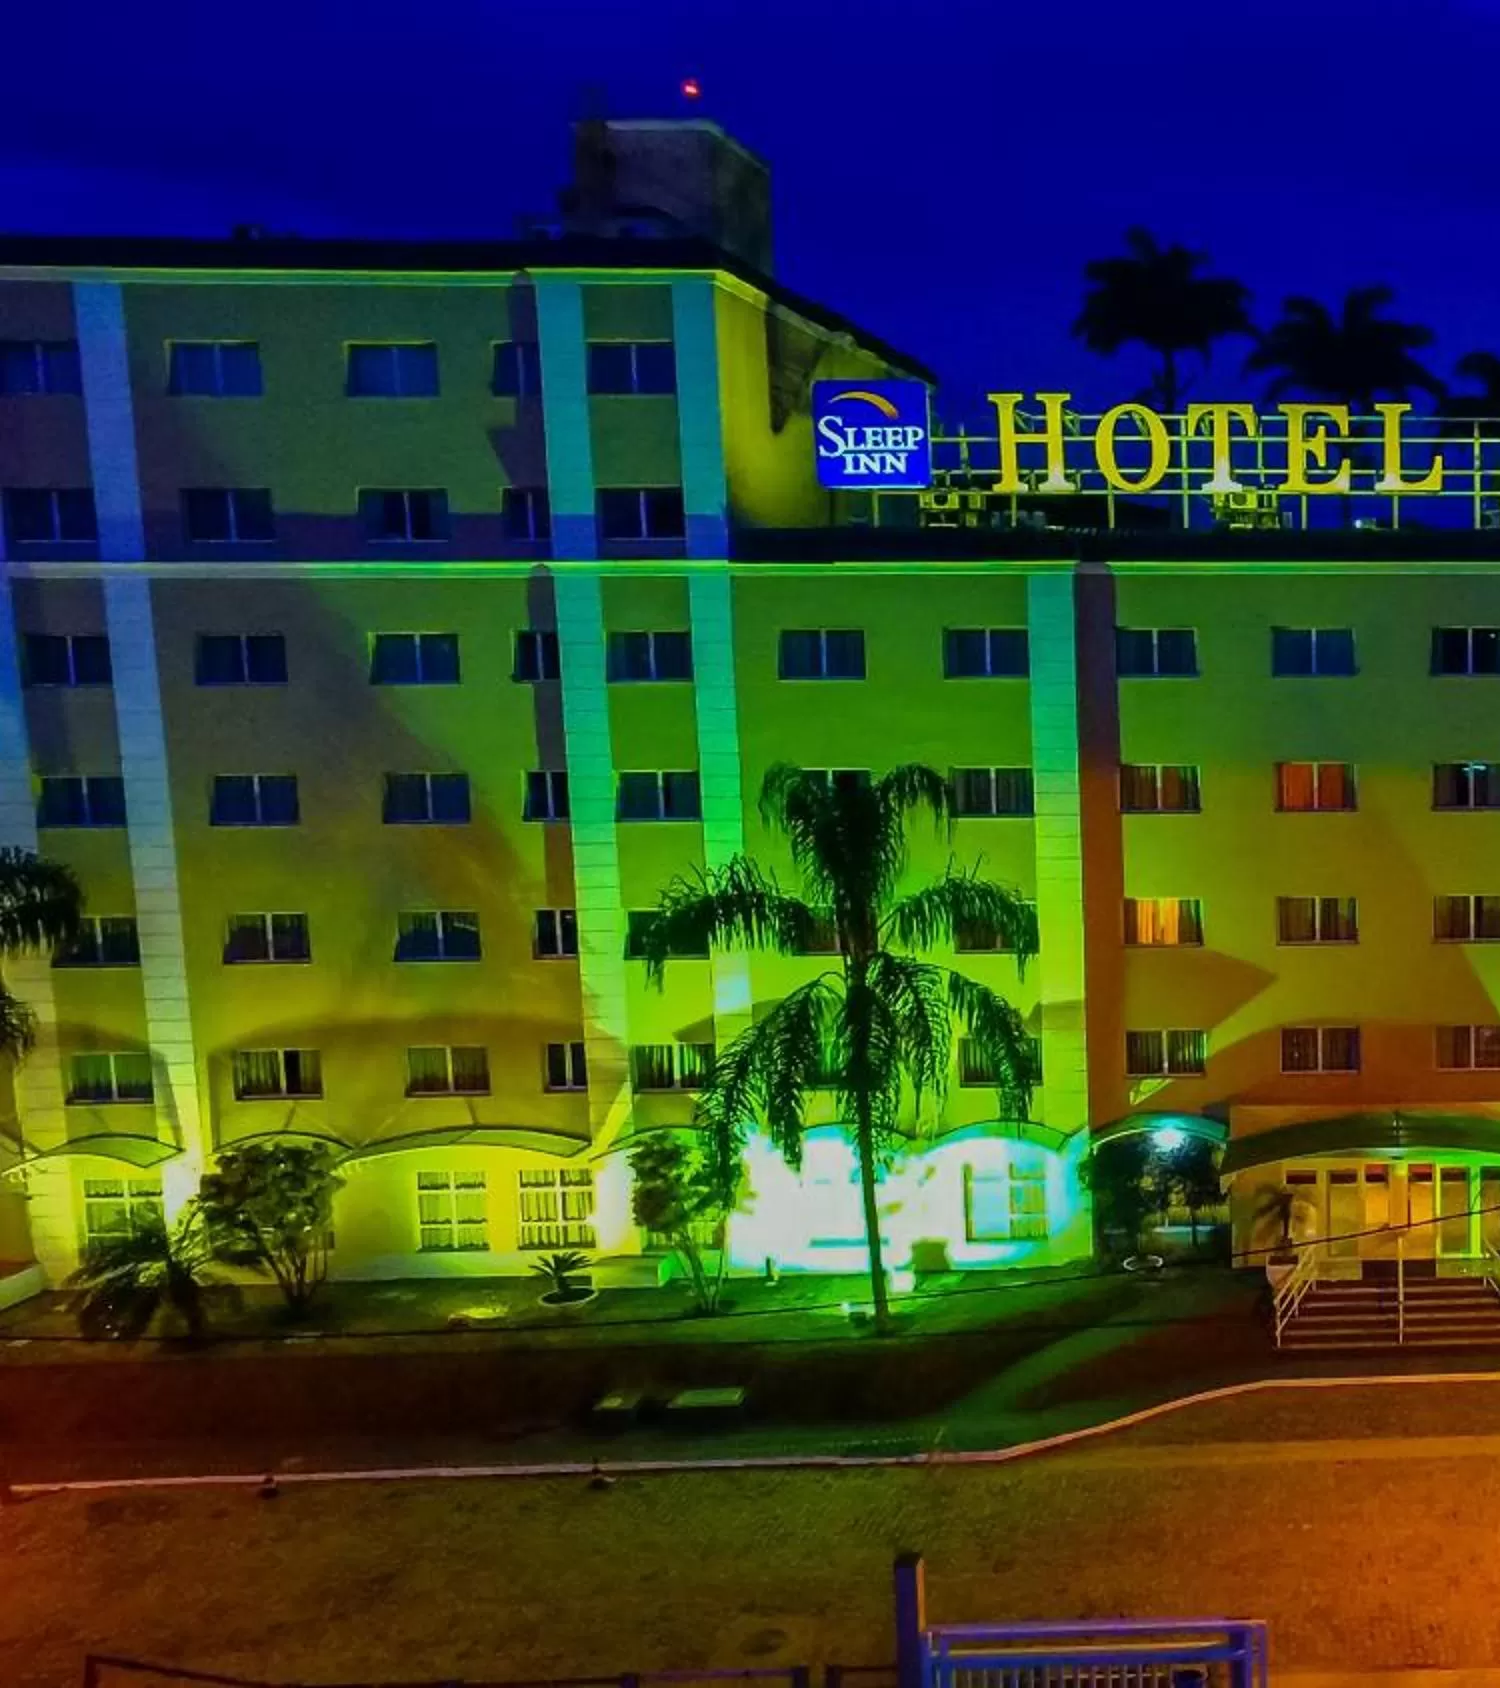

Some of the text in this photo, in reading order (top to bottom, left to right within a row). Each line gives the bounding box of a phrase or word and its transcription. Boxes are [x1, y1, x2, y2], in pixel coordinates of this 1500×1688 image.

[817, 415, 925, 457] SLEEP
[988, 392, 1443, 494] HOTEL
[842, 452, 908, 474] INN
